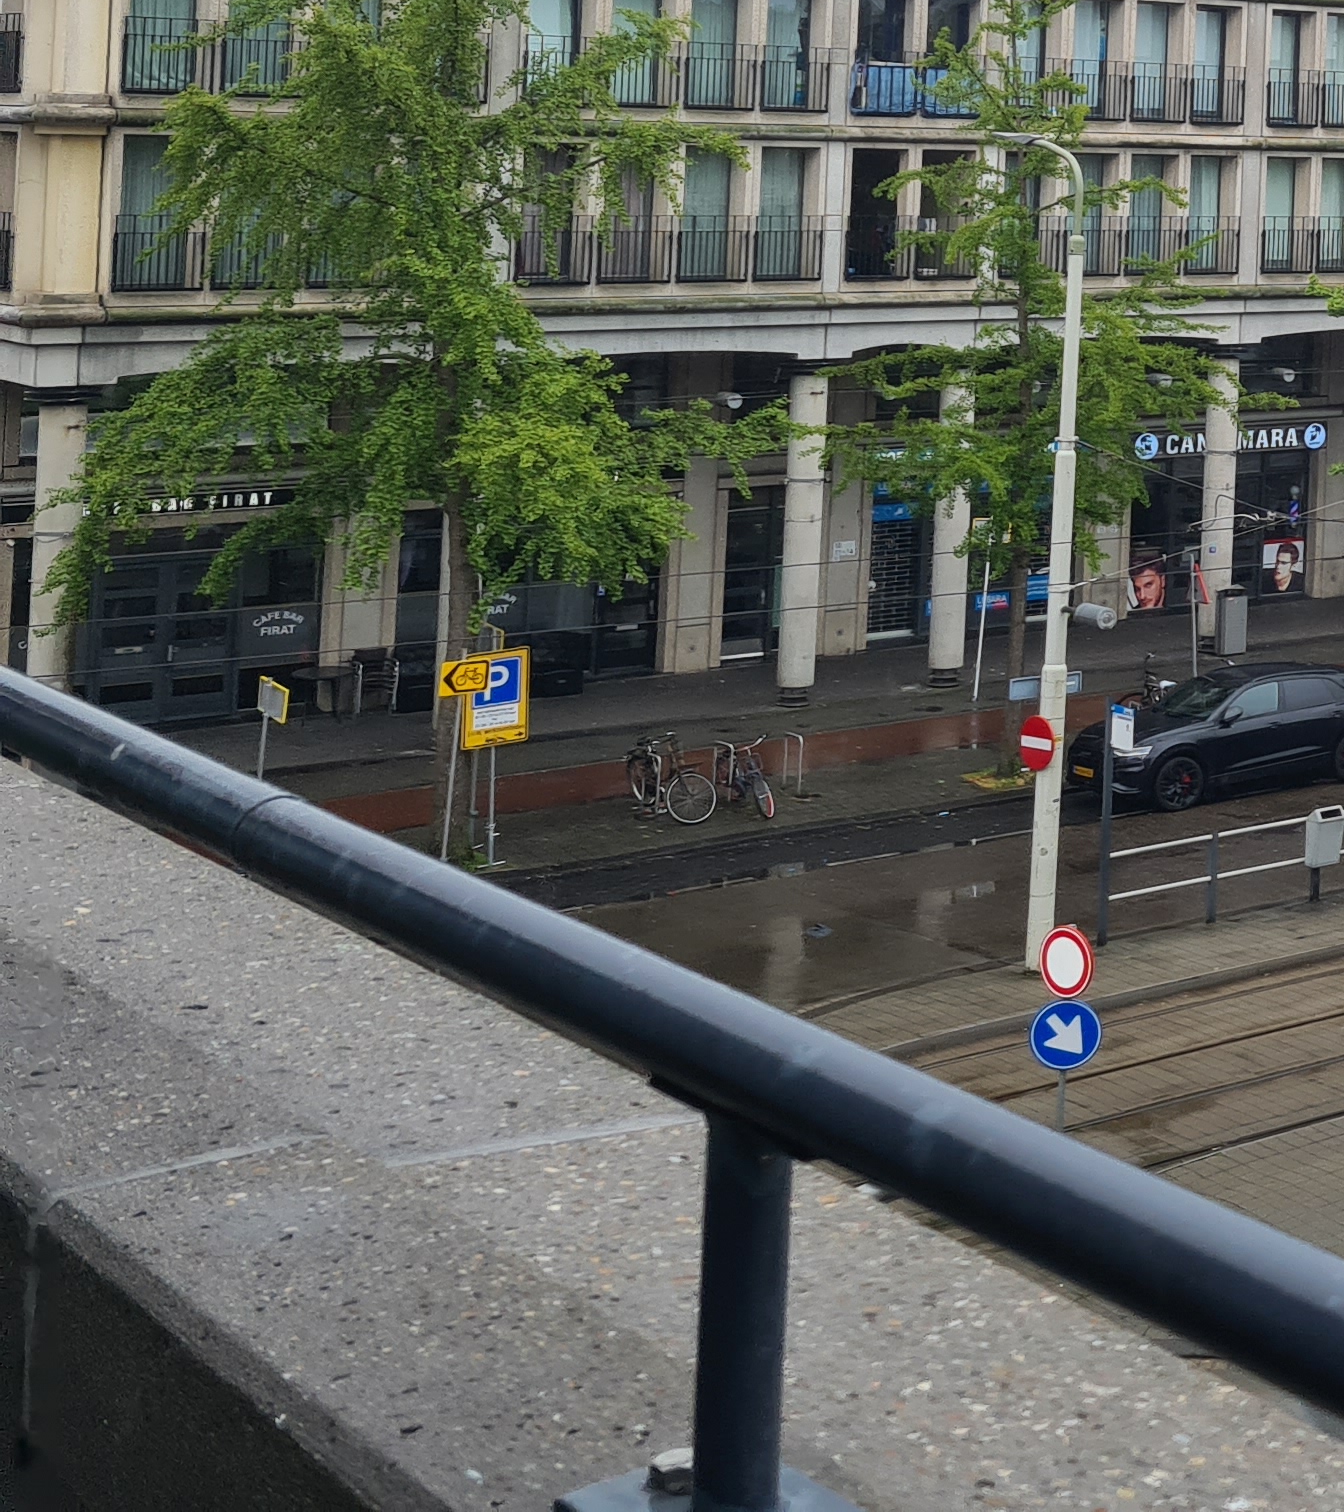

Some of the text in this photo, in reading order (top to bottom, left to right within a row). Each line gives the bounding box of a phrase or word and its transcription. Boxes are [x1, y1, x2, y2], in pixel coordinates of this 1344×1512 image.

[252, 610, 304, 627] CAFE BAR
[260, 624, 297, 637] FIRAT
